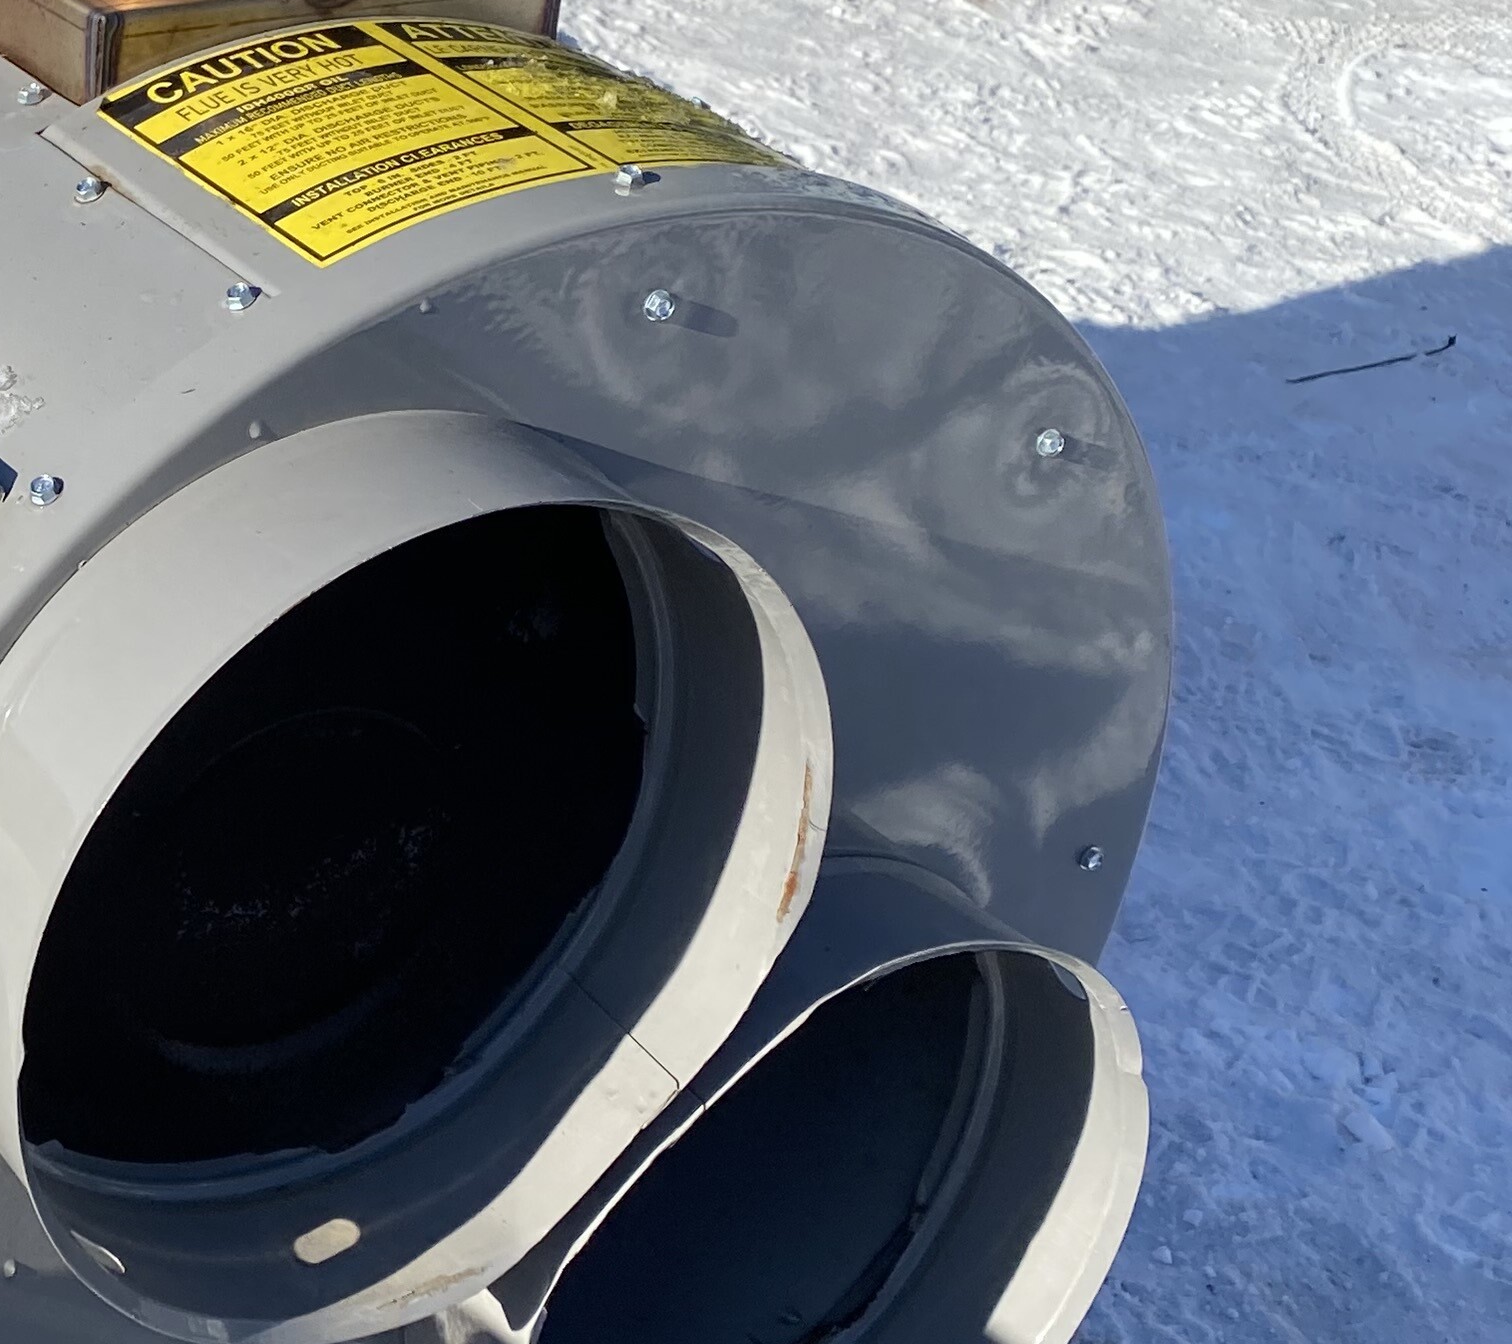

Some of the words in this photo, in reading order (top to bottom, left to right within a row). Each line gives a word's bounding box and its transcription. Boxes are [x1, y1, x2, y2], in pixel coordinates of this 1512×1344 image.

[146, 33, 343, 104] CAUTION
[317, 75, 349, 85] OIL
[174, 90, 236, 120] FLUE
[230, 81, 263, 97] IS
[256, 64, 321, 88] VERY
[315, 53, 366, 71] HOT
[290, 89, 369, 114] DISCHARGE
[370, 81, 407, 91] DUCT
[192, 116, 248, 143] MAXIMUM
[245, 89, 328, 118] RECOMMENDED
[324, 82, 355, 93] DUCT
[264, 120, 291, 131] FEET
[311, 106, 392, 133] DISCHARGE
[234, 140, 263, 153] FEET
[260, 157, 289, 171] FEET
[287, 146, 316, 158] WITH
[363, 121, 392, 131] FEET
[268, 154, 325, 180] ENSURE
[324, 146, 348, 155] NO
[346, 138, 372, 147] AIR
[371, 113, 468, 140] RESTRICTIONS
[290, 137, 318, 148] FEET
[289, 159, 401, 206] INSTALLATION
[342, 185, 369, 196] TOP
[362, 177, 414, 196] BURNER
[310, 212, 346, 229] VENT
[344, 182, 420, 212] CONNECTOR
[432, 168, 467, 179] VENT
[365, 185, 436, 211] DISCHARGE
